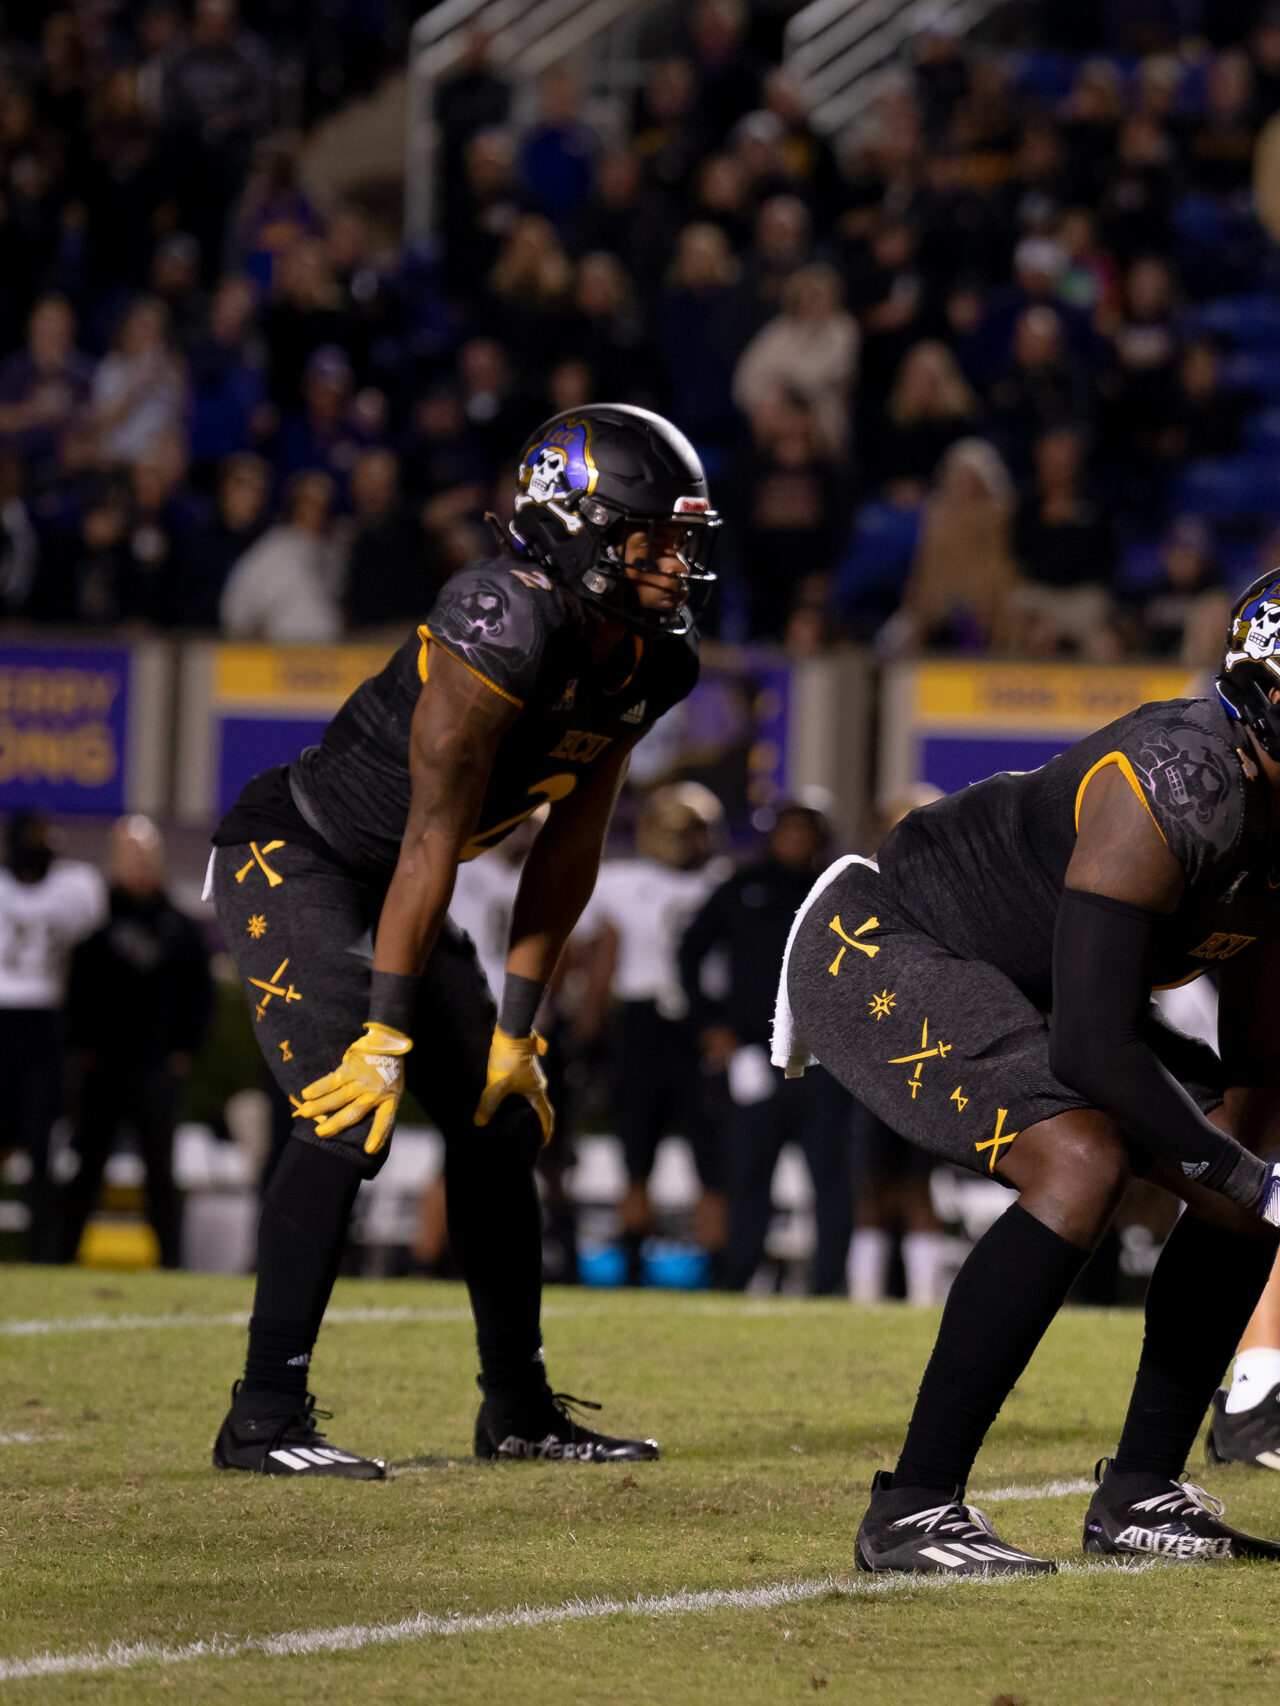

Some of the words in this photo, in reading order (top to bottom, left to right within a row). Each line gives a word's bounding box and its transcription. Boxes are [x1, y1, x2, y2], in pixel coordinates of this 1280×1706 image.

[548, 431, 580, 446] ECU
[509, 569, 553, 591] 2
[544, 729, 614, 764] ECU
[459, 771, 578, 863] 2
[1185, 930, 1258, 961] ECU
[1113, 1524, 1233, 1560] ADIZERO
